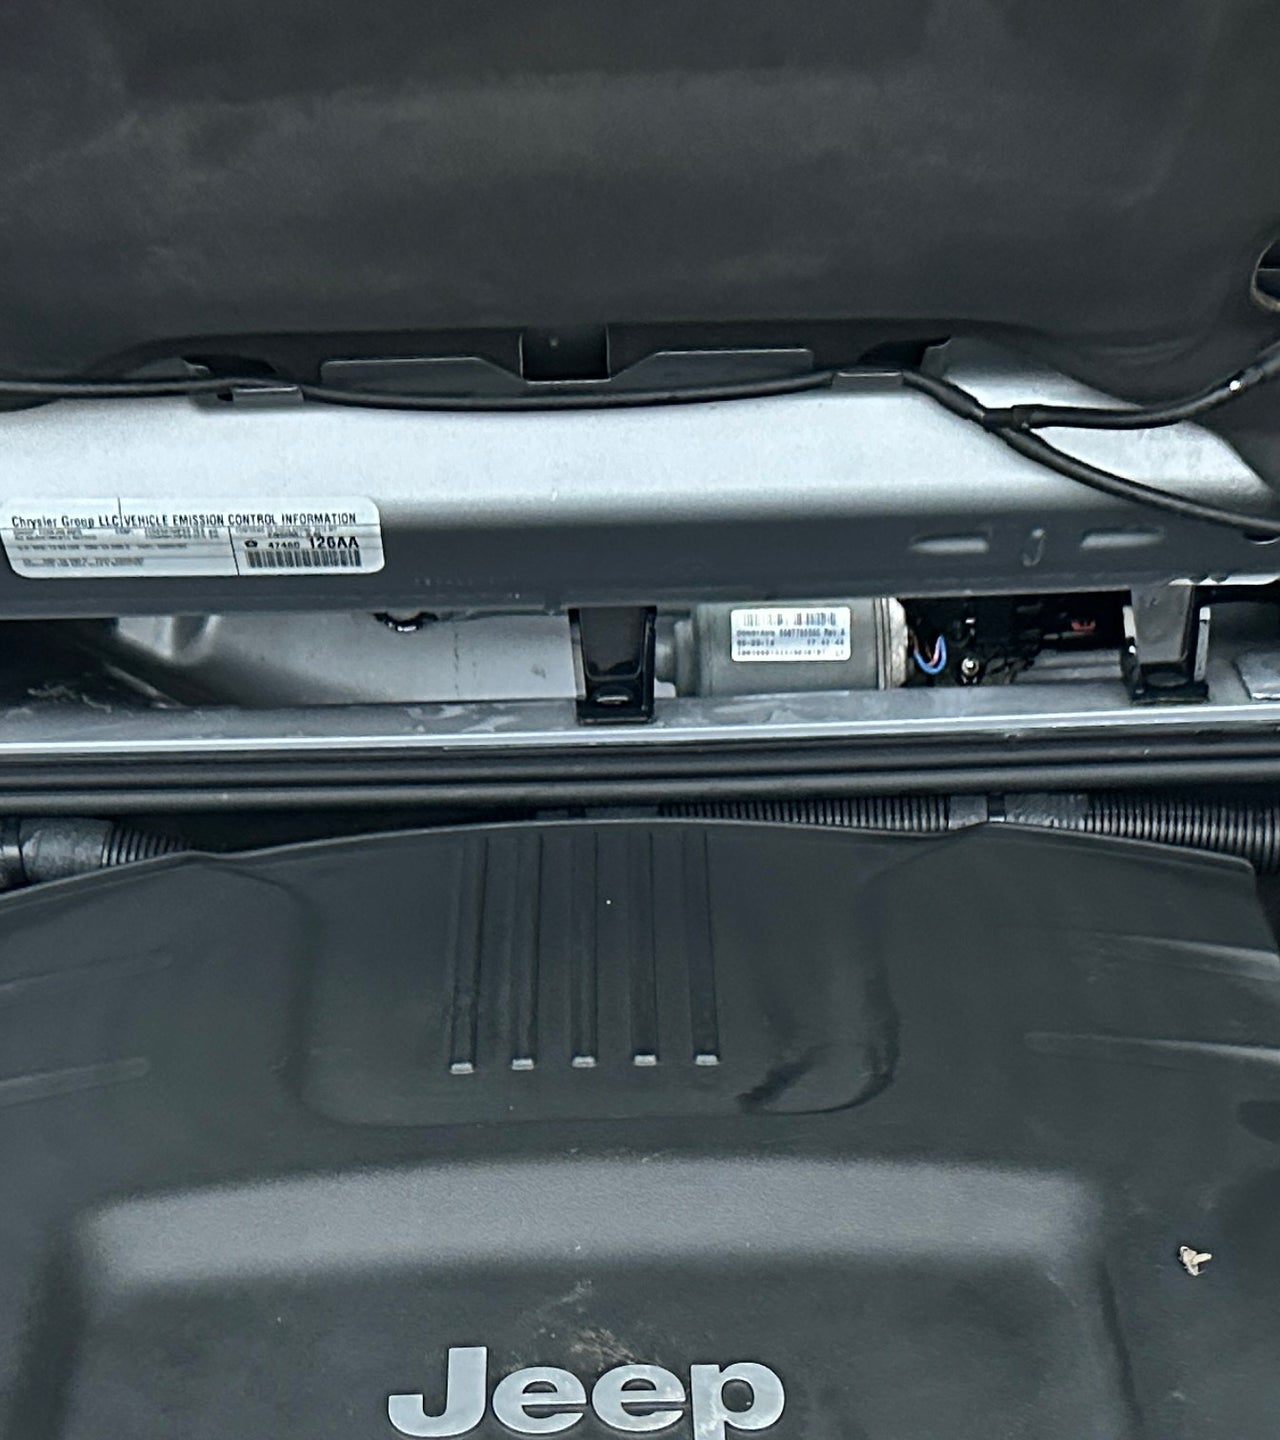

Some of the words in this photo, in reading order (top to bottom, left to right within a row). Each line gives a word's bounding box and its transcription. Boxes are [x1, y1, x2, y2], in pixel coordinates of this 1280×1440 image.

[11, 515, 57, 530] Chrysler
[61, 515, 95, 530] Group
[98, 514, 118, 527] LLC
[123, 514, 168, 527] VEHICLE
[172, 513, 224, 526] EMISSION
[228, 513, 276, 525] CONTROL
[281, 513, 357, 525] INFORMATION
